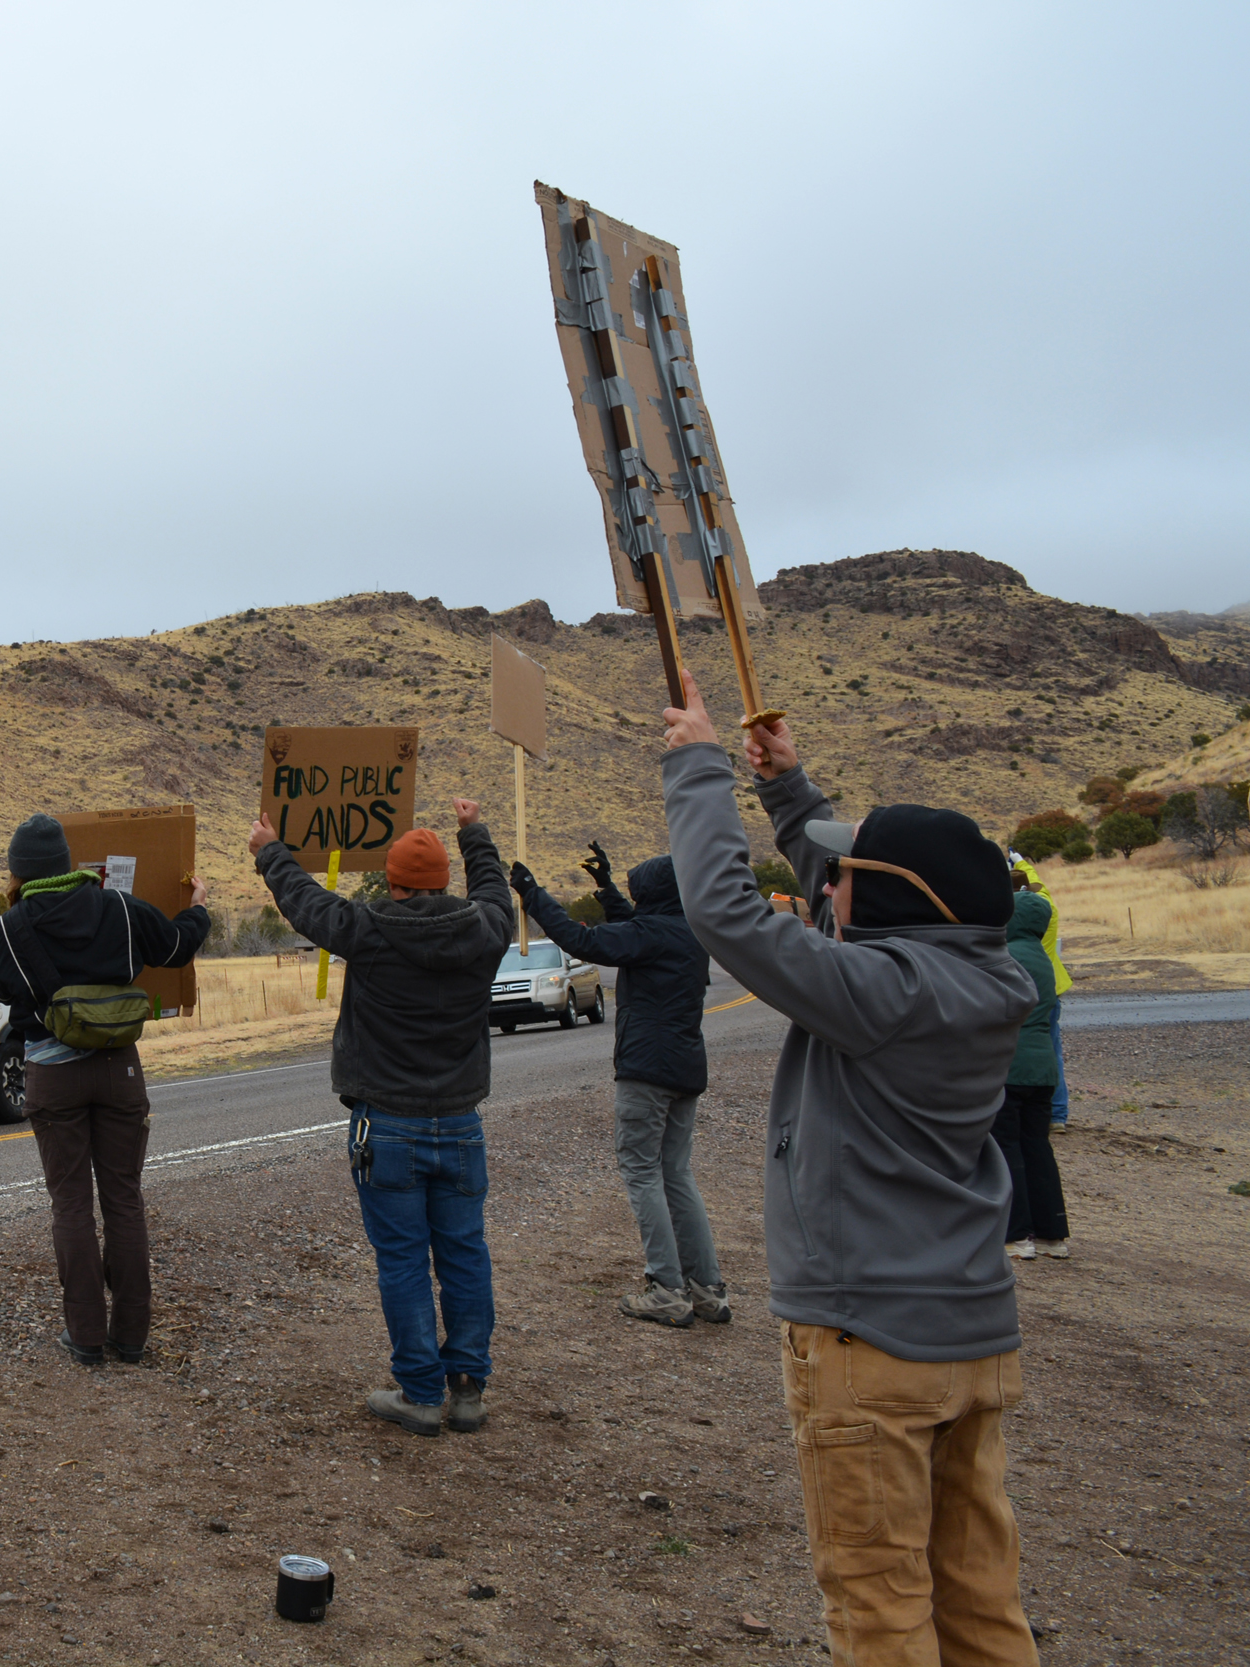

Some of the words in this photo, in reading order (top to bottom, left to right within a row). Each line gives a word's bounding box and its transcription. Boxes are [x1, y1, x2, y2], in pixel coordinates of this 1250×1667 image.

[273, 765, 330, 800] FUND
[340, 764, 403, 797] PUBLIC
[279, 799, 397, 851] LANDS
